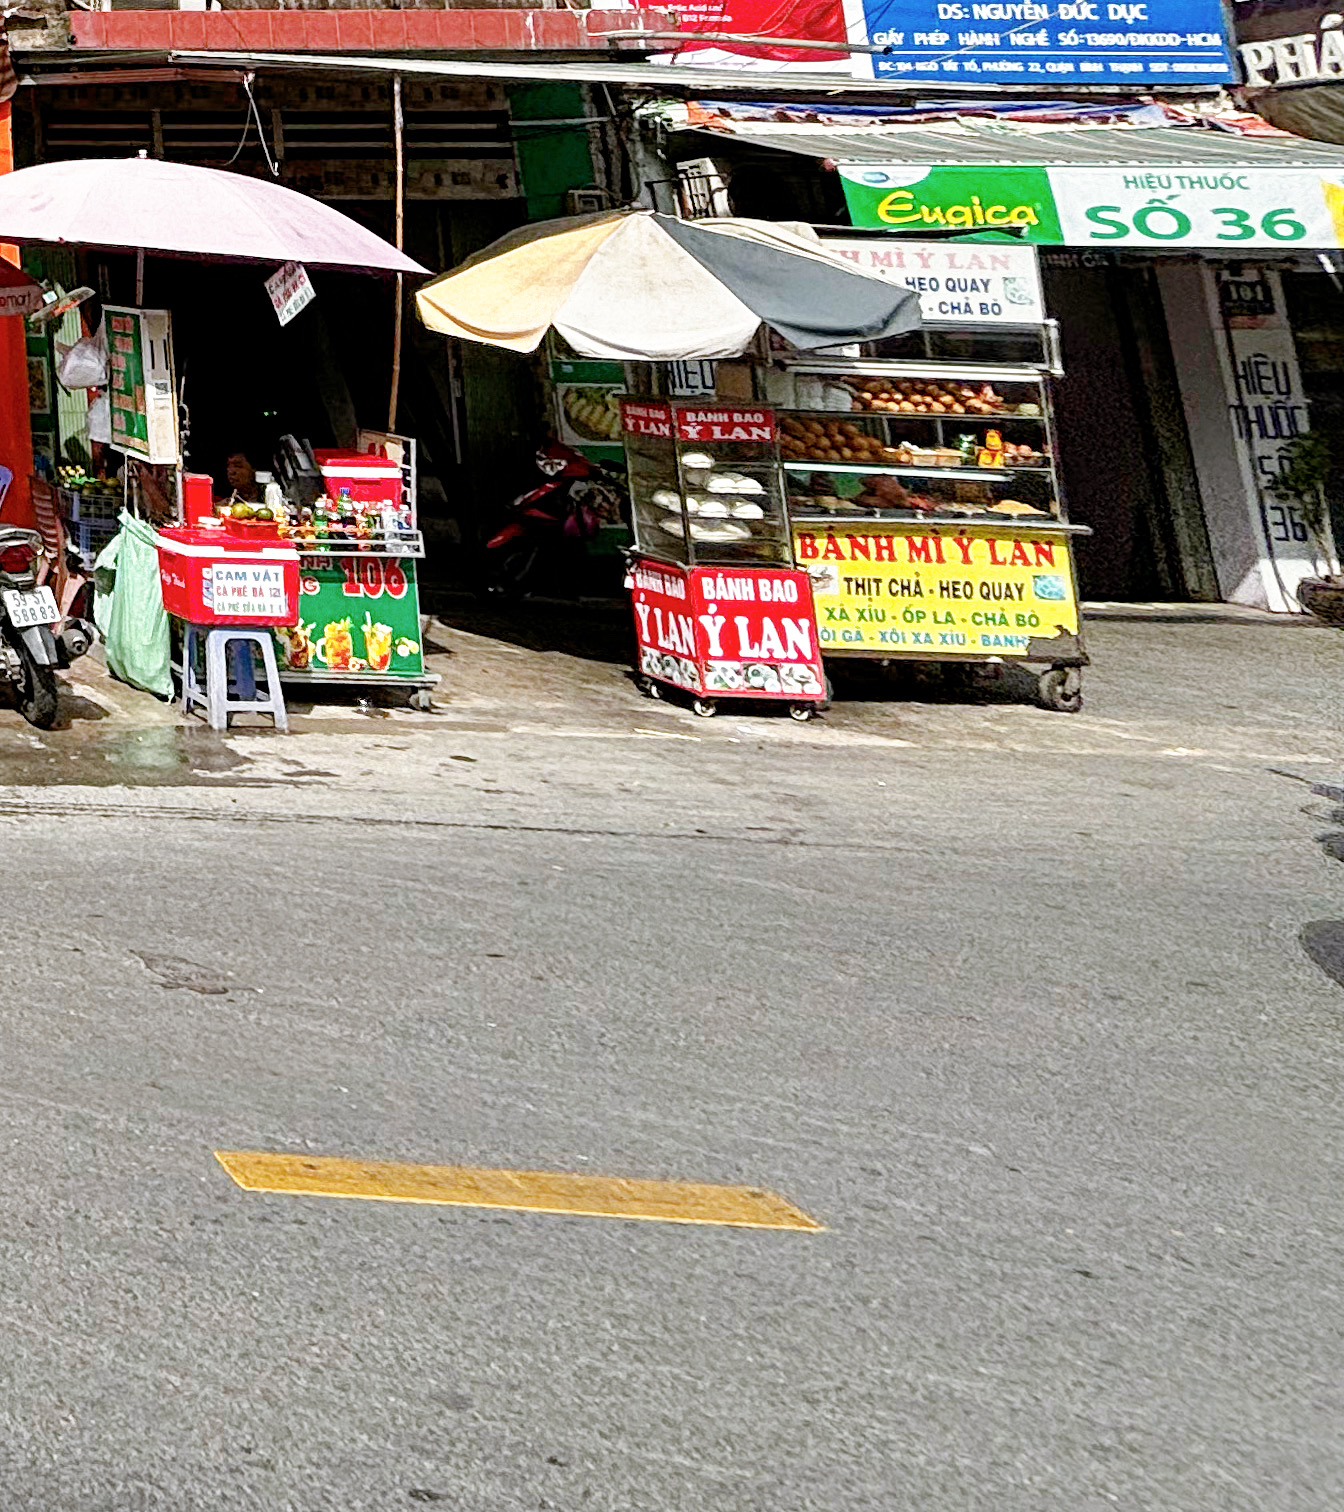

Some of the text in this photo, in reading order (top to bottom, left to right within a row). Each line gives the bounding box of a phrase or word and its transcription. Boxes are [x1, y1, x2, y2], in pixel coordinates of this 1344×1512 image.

[1107, 3, 1149, 25] DỤC
[877, 190, 1040, 228] Eugica
[1085, 194, 1308, 241] SỐ 36
[945, 252, 1012, 271] LAN
[945, 277, 992, 294] QUAY
[640, 420, 671, 437] LAN
[733, 413, 765, 424] BAO
[712, 425, 772, 440] LAN
[797, 525, 898, 563] BÁNH
[905, 528, 946, 565] MÌ
[985, 538, 1056, 568] LAN
[215, 569, 247, 582] CAM
[342, 556, 410, 599] 106
[701, 572, 799, 603] BÁNH BAO
[843, 571, 1025, 603] THỊT CHẢ HEO QUAY
[933, 610, 956, 626] LA
[971, 607, 1009, 627] CHẢ
[654, 607, 697, 658] LAN
[698, 603, 813, 660] Ý LAN
